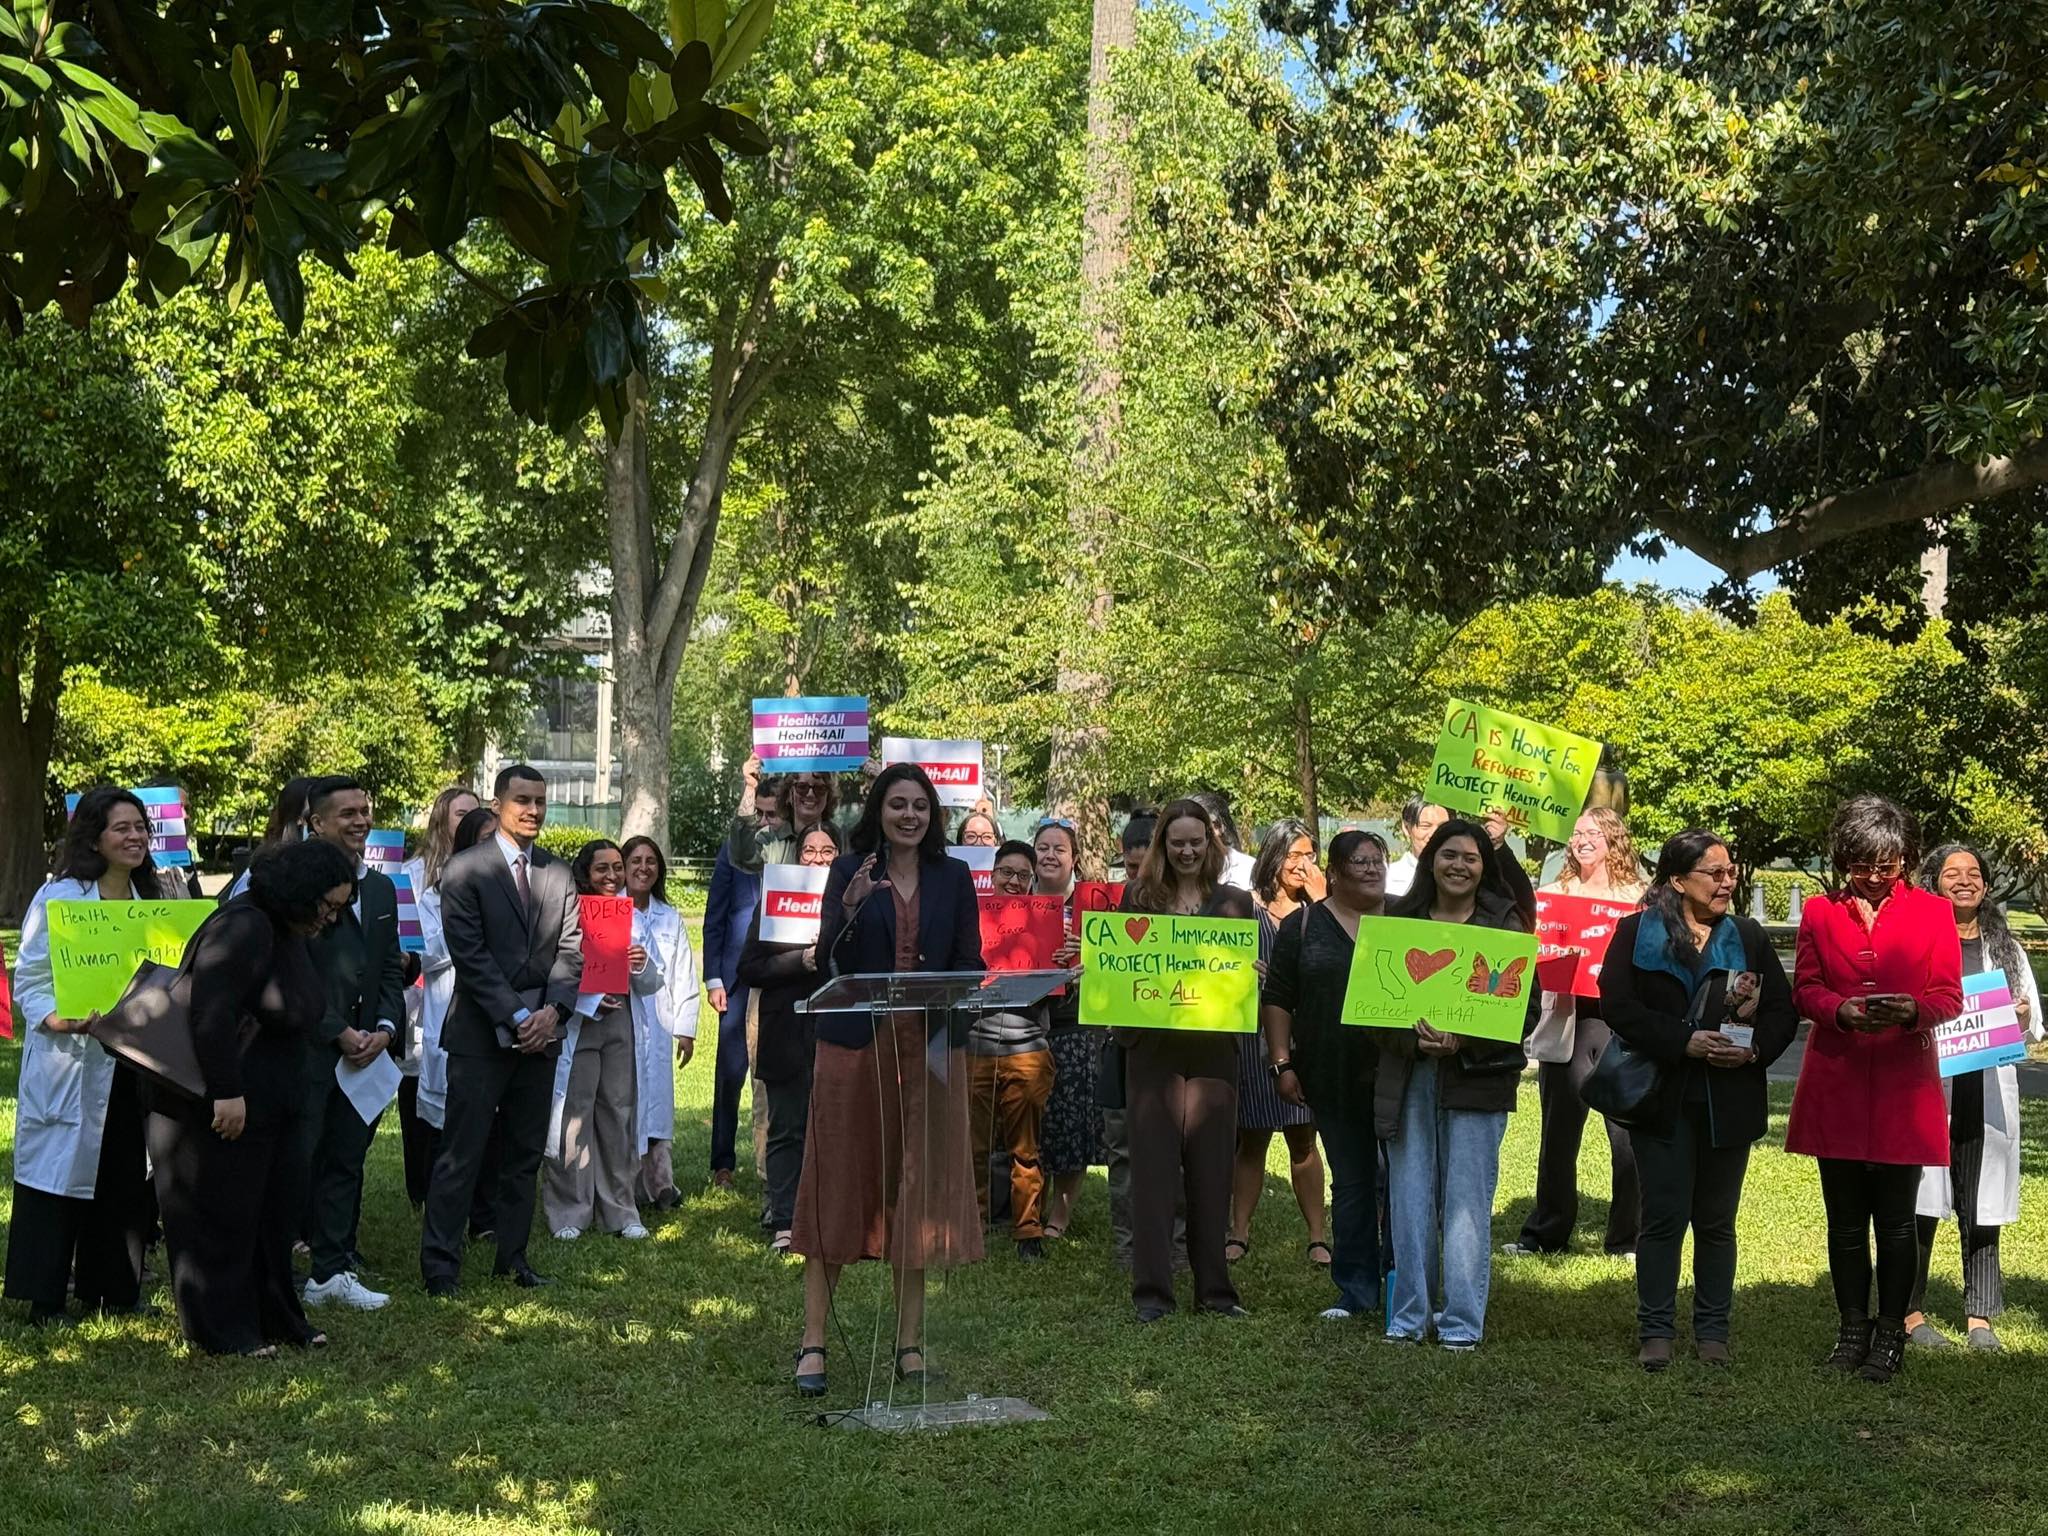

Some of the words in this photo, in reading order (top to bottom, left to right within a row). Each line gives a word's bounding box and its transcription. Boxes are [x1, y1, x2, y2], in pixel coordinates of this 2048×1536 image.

[777, 713, 845, 727] Health4All
[778, 728, 846, 741] Health4All
[1447, 708, 1479, 743] CA
[1489, 729, 1503, 747] IS
[1511, 728, 1556, 764] HOME
[1560, 746, 1581, 776] FOR
[777, 743, 846, 757] Health4All
[1435, 763, 1500, 795] PROTECT
[1503, 784, 1540, 807] HEALTH
[1540, 794, 1571, 817] CARE
[1507, 805, 1530, 824] ALL
[60, 906, 110, 926] Health
[127, 905, 171, 920] Care
[88, 925, 98, 935] is
[112, 925, 122, 933] a
[1085, 917, 1118, 947] CA
[1171, 919, 1254, 947] IMMIGRANTS
[59, 947, 119, 969] Human
[1099, 953, 1162, 975] PROTECT
[1166, 954, 1205, 973] HEALTH
[1209, 957, 1242, 973] CARE
[1132, 978, 1162, 1002] FOR
[1169, 979, 1202, 1001] ALL
[1355, 1001, 1414, 1017] Protect
